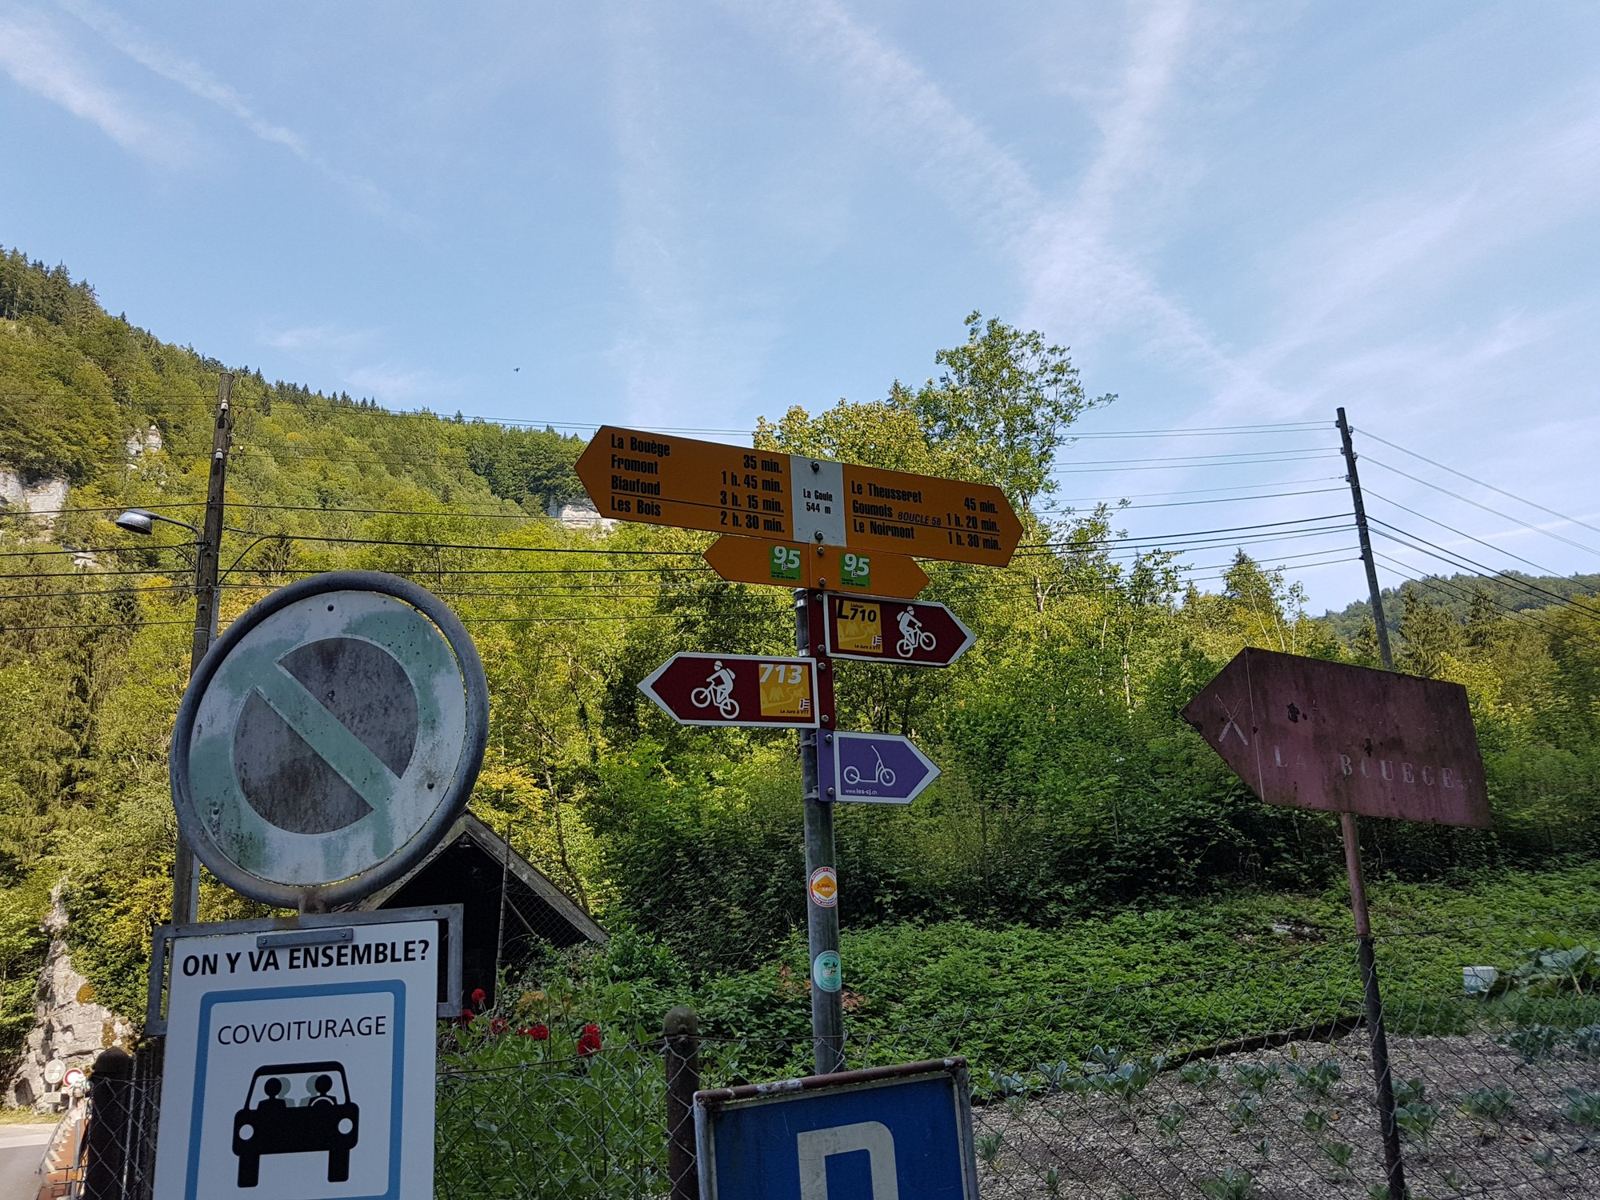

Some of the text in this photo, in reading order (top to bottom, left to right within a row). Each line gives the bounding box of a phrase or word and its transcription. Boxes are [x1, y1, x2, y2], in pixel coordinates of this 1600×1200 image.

[611, 433, 782, 473] La Bouège 35 min.
[611, 454, 783, 493] Fromont 1 h. 45 min.
[611, 475, 784, 513] Biaufond 3 h. 15 min.
[803, 488, 811, 499] La
[806, 502, 831, 514] 544 m
[851, 480, 998, 514] Le Theusseret 45 min.
[611, 495, 785, 533] Les Bois 2 h. 30 min.
[852, 499, 893, 518] Goumois
[898, 511, 929, 525] BOUCLE
[946, 513, 951, 526] 1
[954, 514, 963, 528] h.
[966, 515, 978, 529] 20
[981, 518, 1000, 533] min.
[853, 518, 1002, 551] Le Noirmont 1 h. 30 min.
[774, 545, 800, 569] 95
[844, 553, 870, 576] 95
[759, 664, 803, 685] 713
[182, 939, 430, 977] ON Y VA ENSEMBLE?
[217, 1016, 387, 1046] COVOITURAGE
